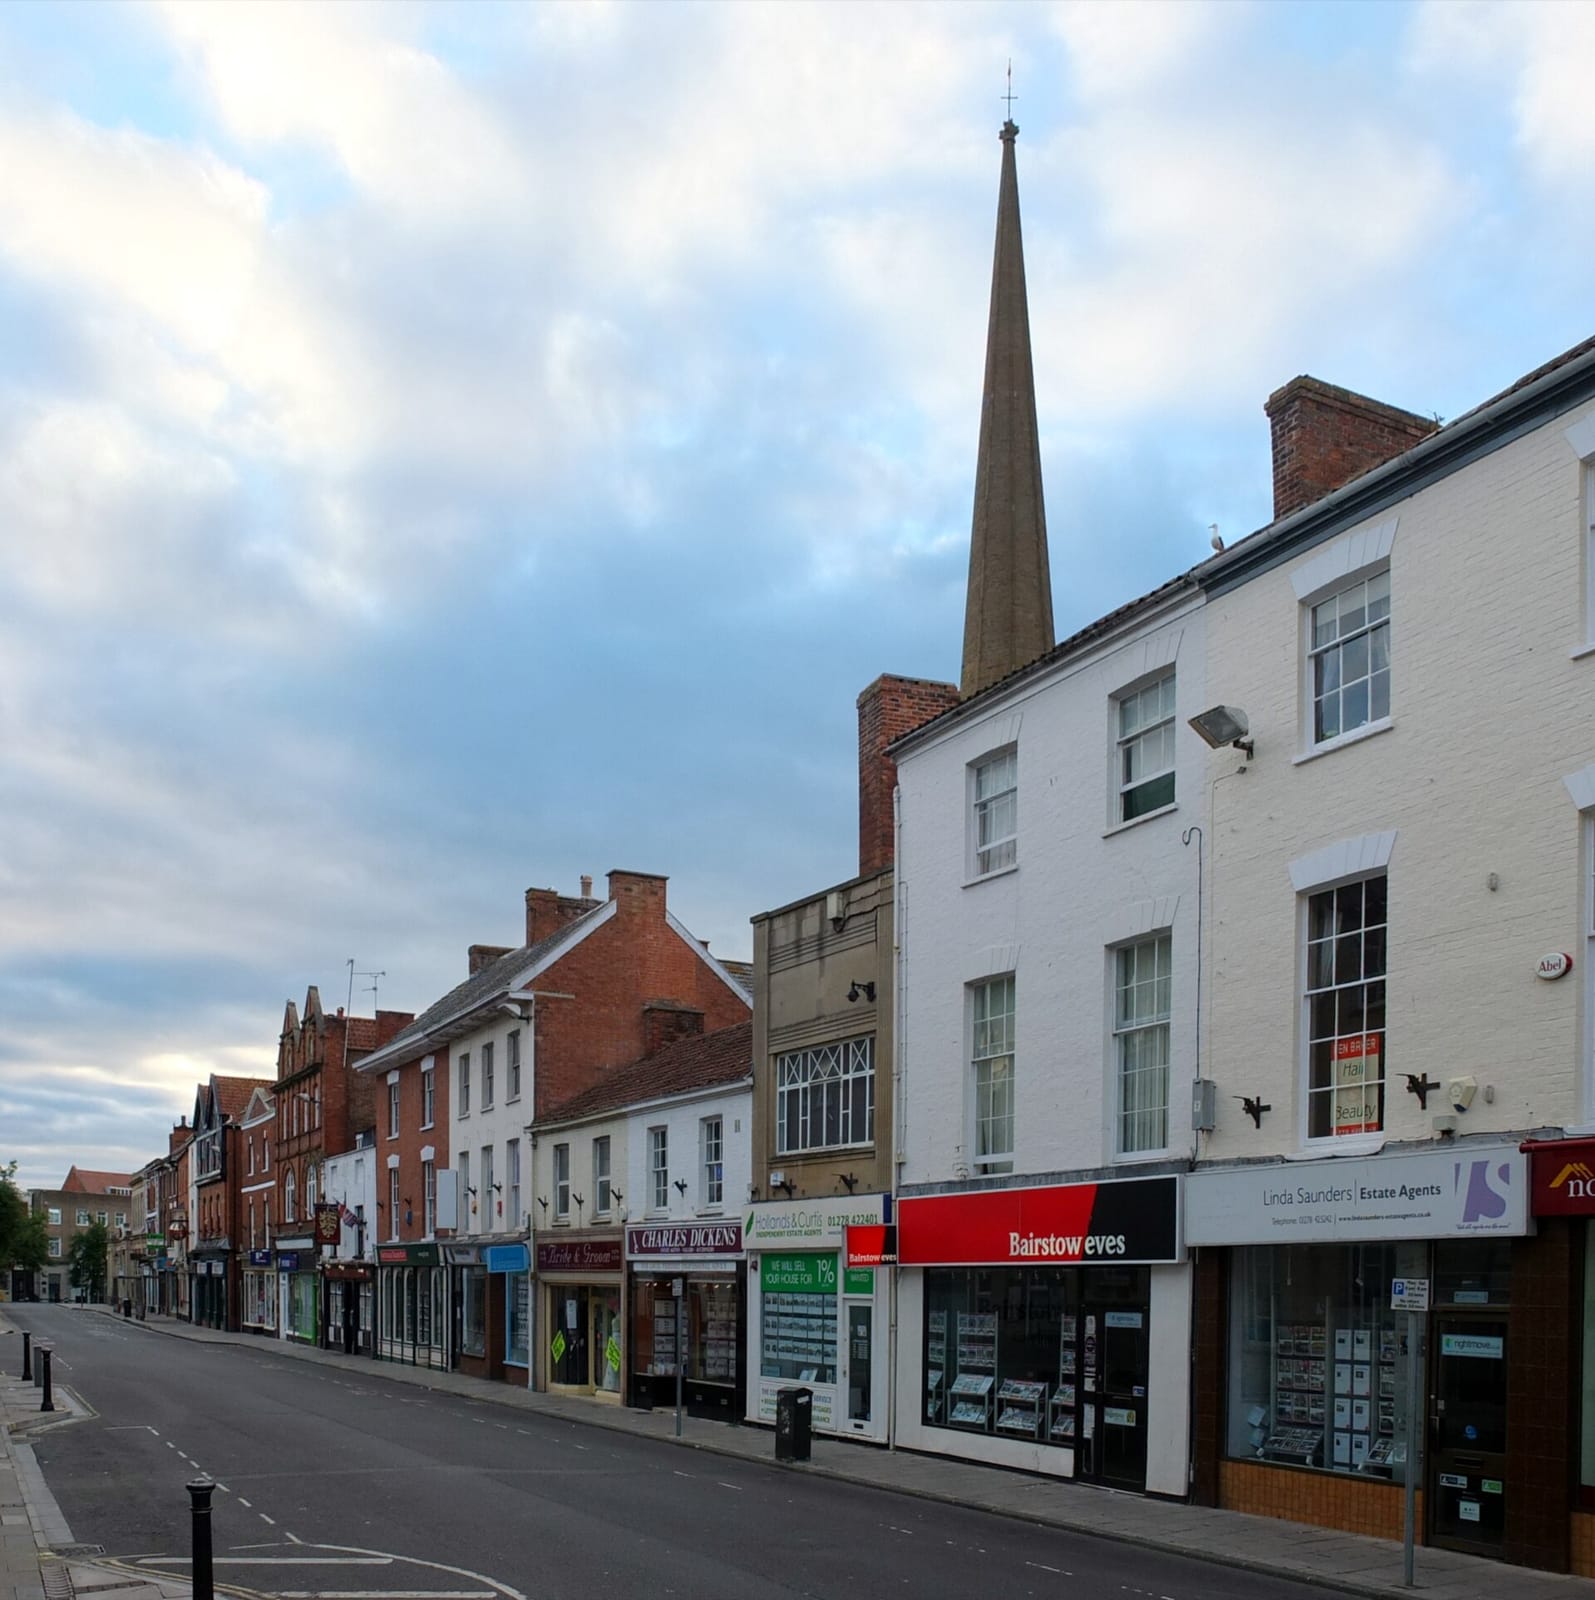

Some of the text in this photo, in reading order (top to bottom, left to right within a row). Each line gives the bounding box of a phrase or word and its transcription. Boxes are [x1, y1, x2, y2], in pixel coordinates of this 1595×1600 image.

[1537, 958, 1562, 973] Abel
[1336, 1103, 1377, 1120] Beauty
[1263, 1185, 1353, 1206] Linda Saunders
[1360, 1184, 1442, 1201] Estate Agents
[828, 1213, 879, 1227] 01278 422401
[642, 1226, 737, 1248] CHARLES DICKENS
[1008, 1232, 1127, 1257] Bairstow eves
[547, 1244, 572, 1264] Bride
[583, 1243, 611, 1263] Groom
[849, 1252, 897, 1263] Bairstow eves
[771, 1259, 806, 1271] WE WILL SELL
[816, 1259, 835, 1283] 1%
[765, 1273, 813, 1284] YOUR HOUSE FOR
